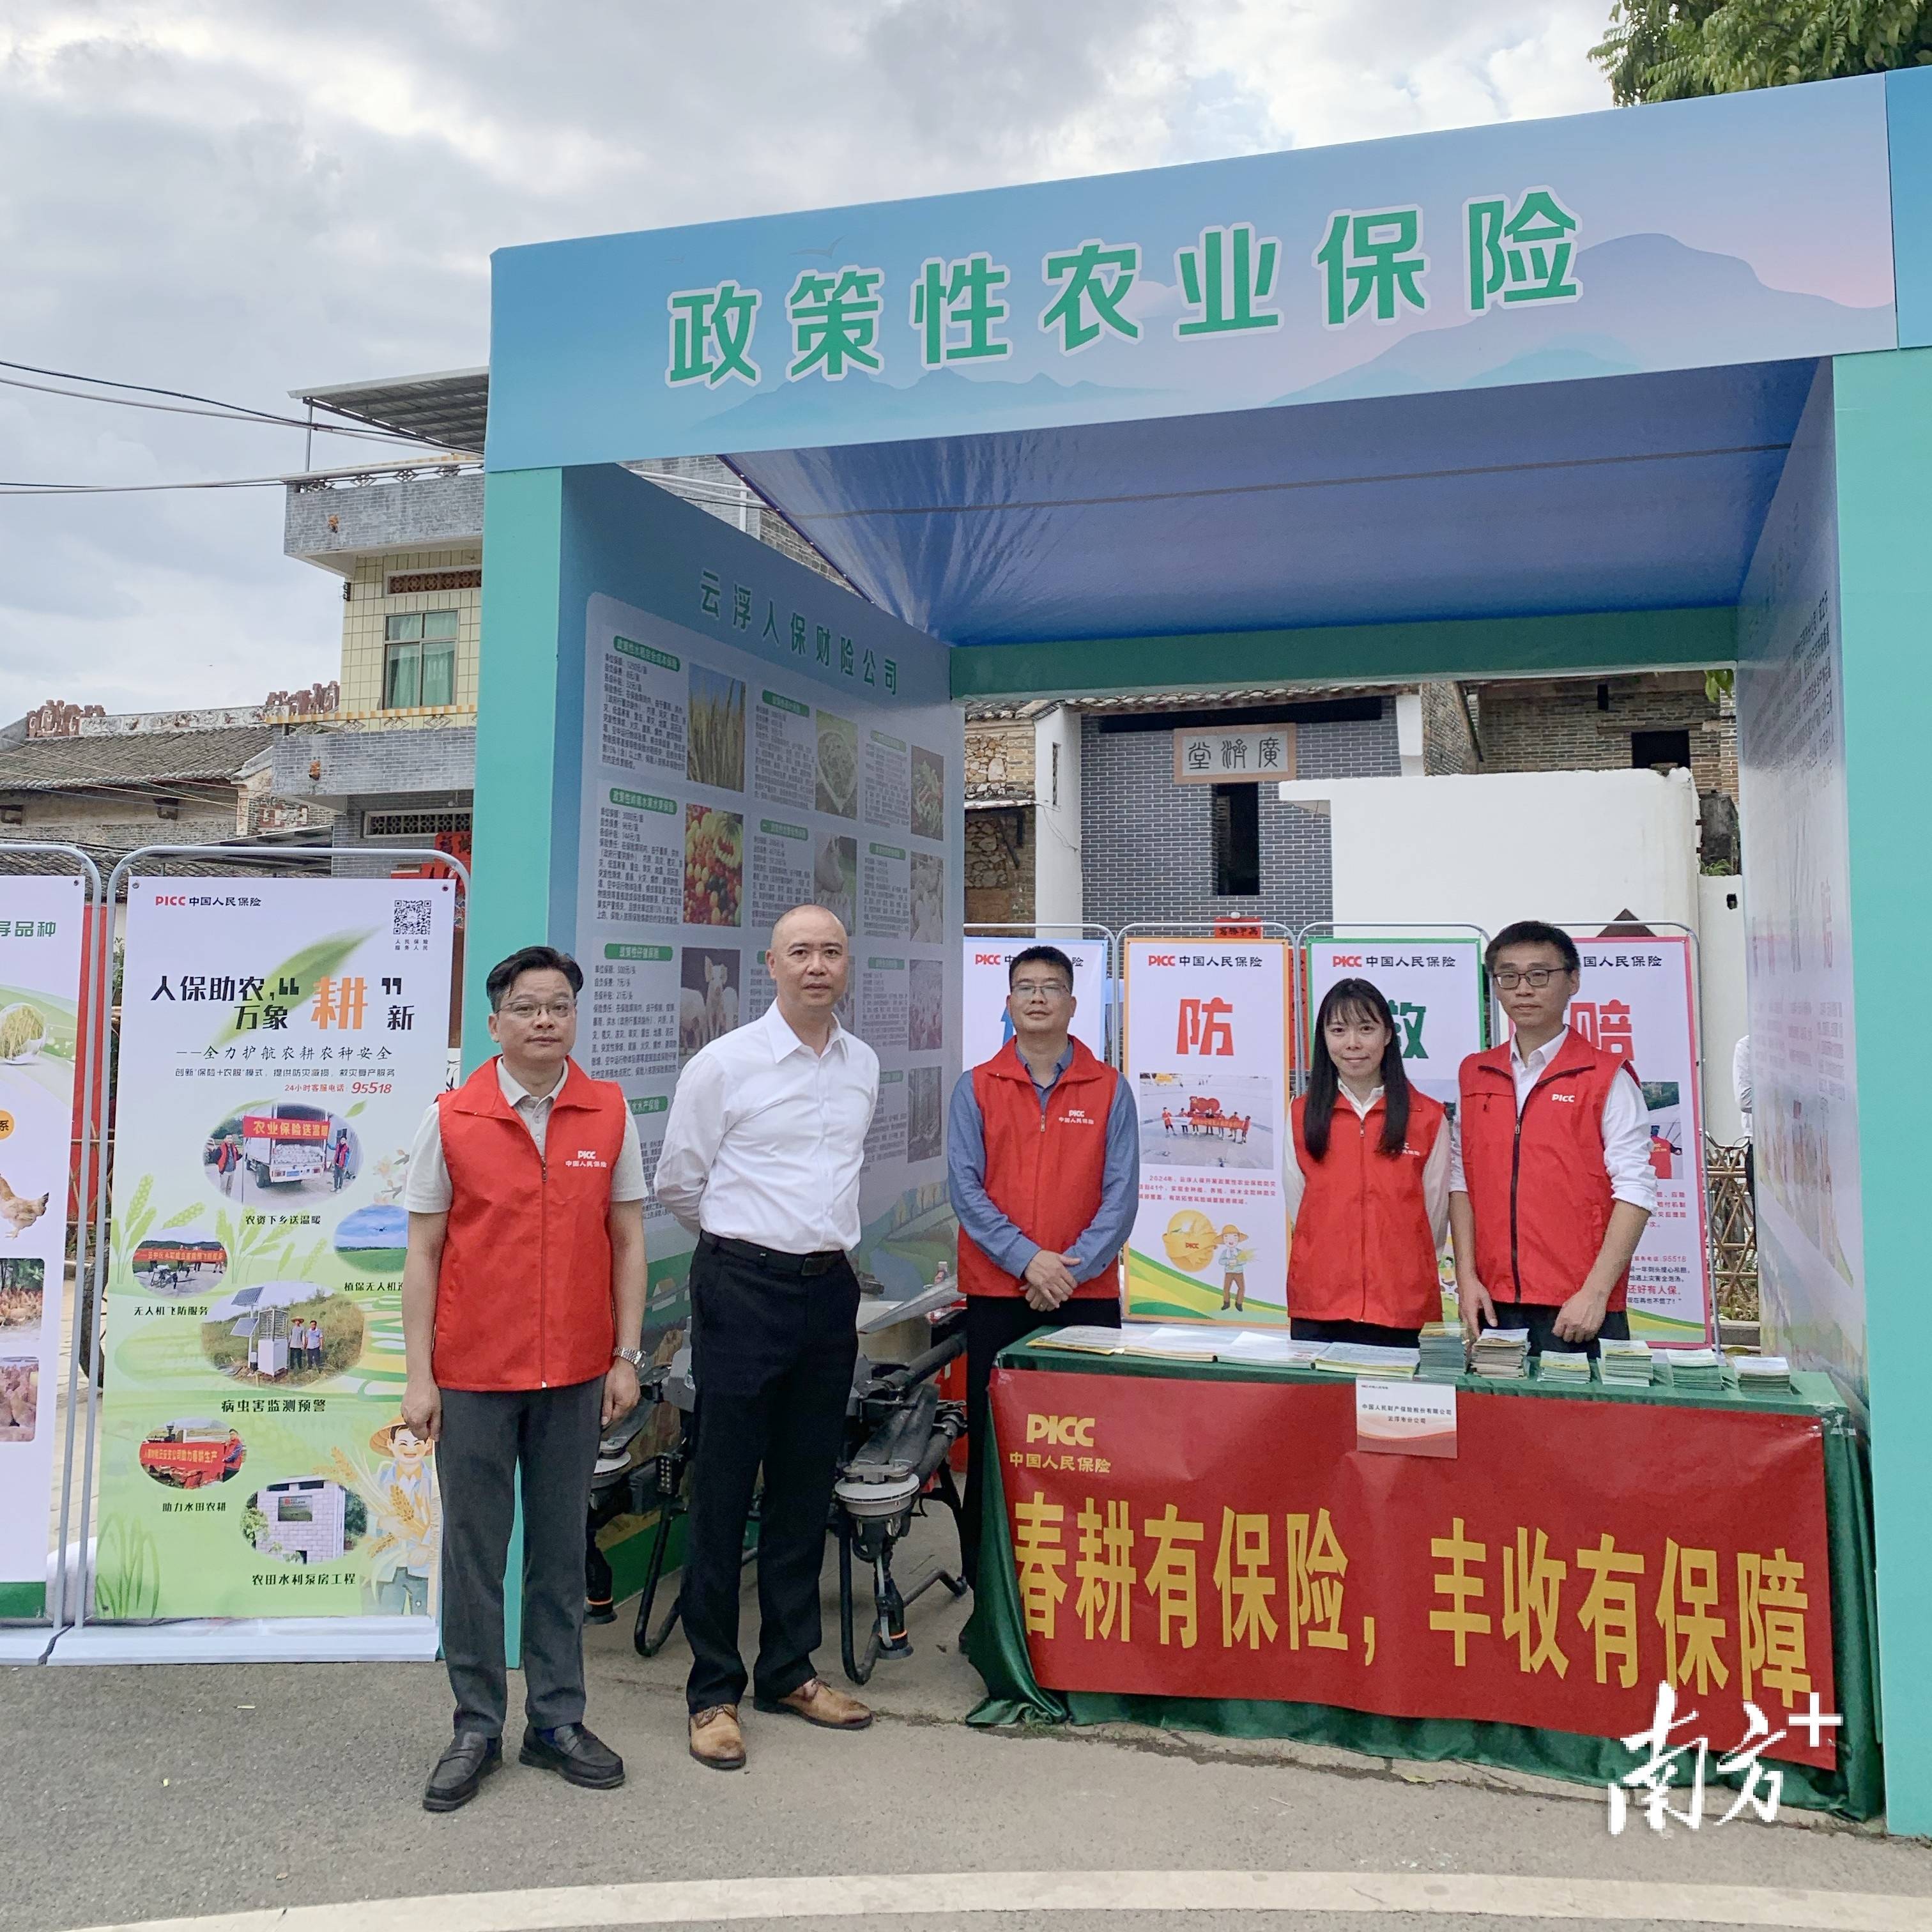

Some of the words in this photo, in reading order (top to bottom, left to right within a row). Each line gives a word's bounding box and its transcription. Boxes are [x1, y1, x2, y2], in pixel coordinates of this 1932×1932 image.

[665, 186, 1583, 388] 政策性农业保险
[700, 569, 898, 696] 云浮人保财险公司
[155, 896, 186, 906] PICC
[189, 896, 262, 907] 中国人民保险
[976, 954, 1001, 965] PICC
[1149, 956, 1176, 967] PICC
[1179, 955, 1263, 967] 中国人民保险
[1333, 956, 1362, 967] PICC
[1366, 955, 1456, 967] 中国人民保险
[1583, 955, 1662, 967] 国人民保险
[1176, 997, 1234, 1056] 防
[1570, 999, 1634, 1061] 赔
[351, 1082, 392, 1094] 95518
[1552, 1093, 1575, 1103] PICC
[254, 1121, 328, 1137] 农业保险送温暖
[578, 1150, 596, 1159] PICC
[245, 1215, 321, 1225] 农资下乡送温暖
[134, 1306, 208, 1316] 无人机飞防服务
[221, 1399, 326, 1413] 病虫害监测预警
[1026, 1413, 1095, 1447] PICC
[1009, 1452, 1111, 1474] 中国人民保险
[162, 1502, 226, 1512] 助力水田农耕
[252, 1573, 356, 1585] 农田水利泵房工程
